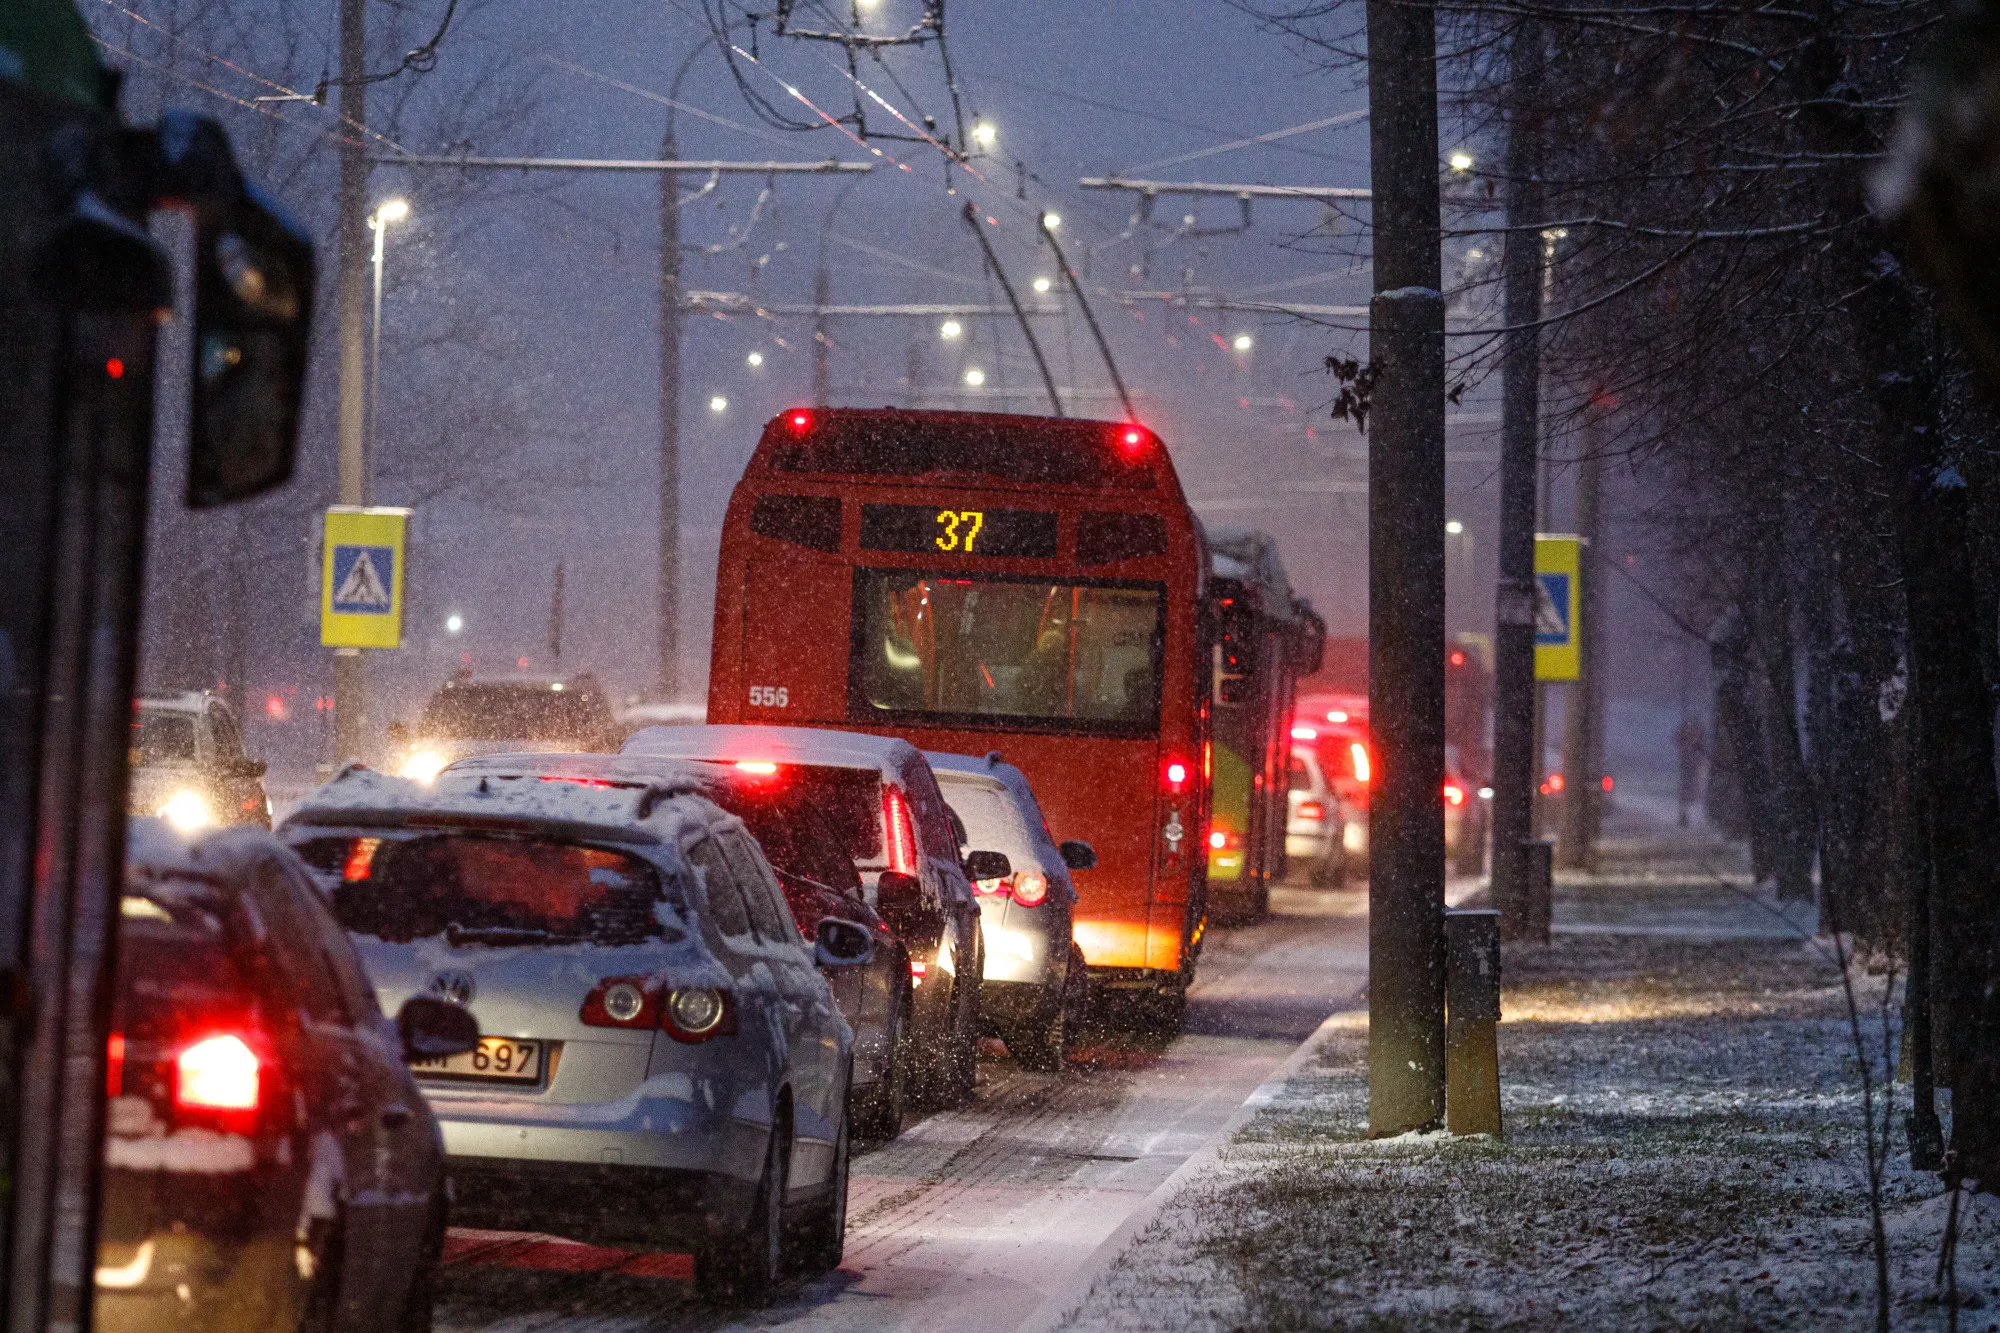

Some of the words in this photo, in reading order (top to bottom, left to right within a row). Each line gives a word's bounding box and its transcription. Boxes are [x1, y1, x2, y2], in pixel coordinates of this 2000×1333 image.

[936, 510, 983, 552] 37
[749, 685, 789, 708] 556
[473, 1043, 534, 1073] 697
